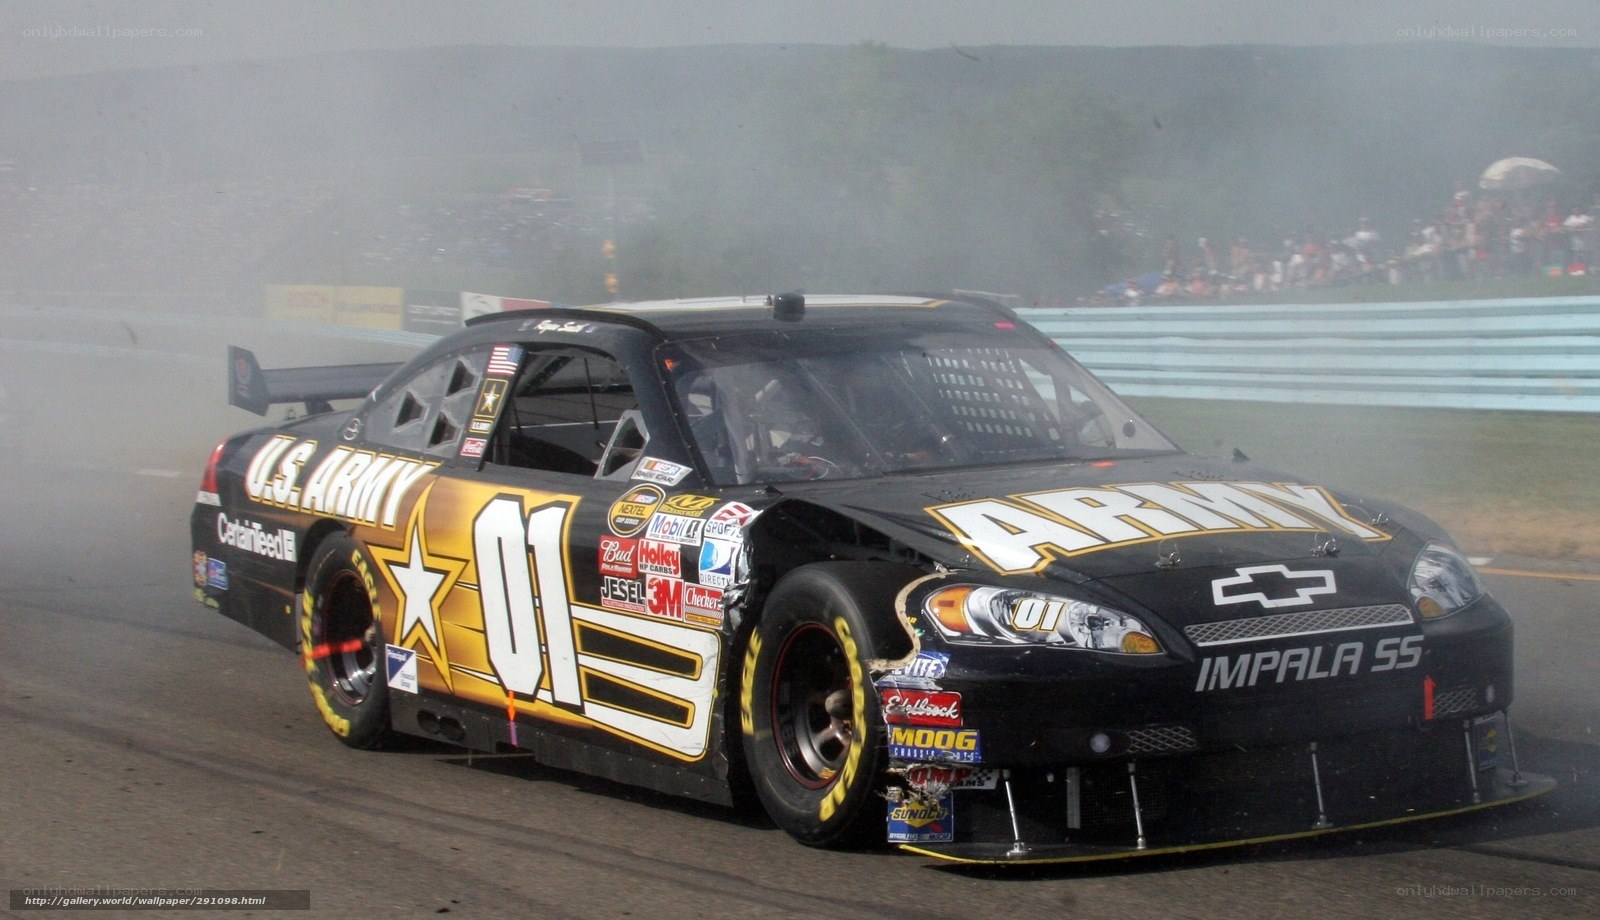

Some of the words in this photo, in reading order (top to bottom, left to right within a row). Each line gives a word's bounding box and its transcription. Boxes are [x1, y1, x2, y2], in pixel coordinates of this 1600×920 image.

[245, 435, 318, 511] U.S.
[301, 445, 442, 530] ARMY
[619, 504, 646, 516] NEXTEL
[651, 514, 686, 536] Mobil
[218, 512, 285, 560] CertainTeed
[924, 481, 1394, 576] ARMY
[601, 540, 635, 562] Bud
[640, 540, 679, 575] Holley
[650, 565, 673, 574] CARBS
[473, 493, 586, 713] 01
[601, 576, 646, 604] JESEL
[647, 577, 683, 619] 3M
[1011, 598, 1066, 633] 01
[1195, 642, 1363, 692] IMPALA
[1371, 634, 1424, 672] SS
[890, 727, 978, 751] MOOG
